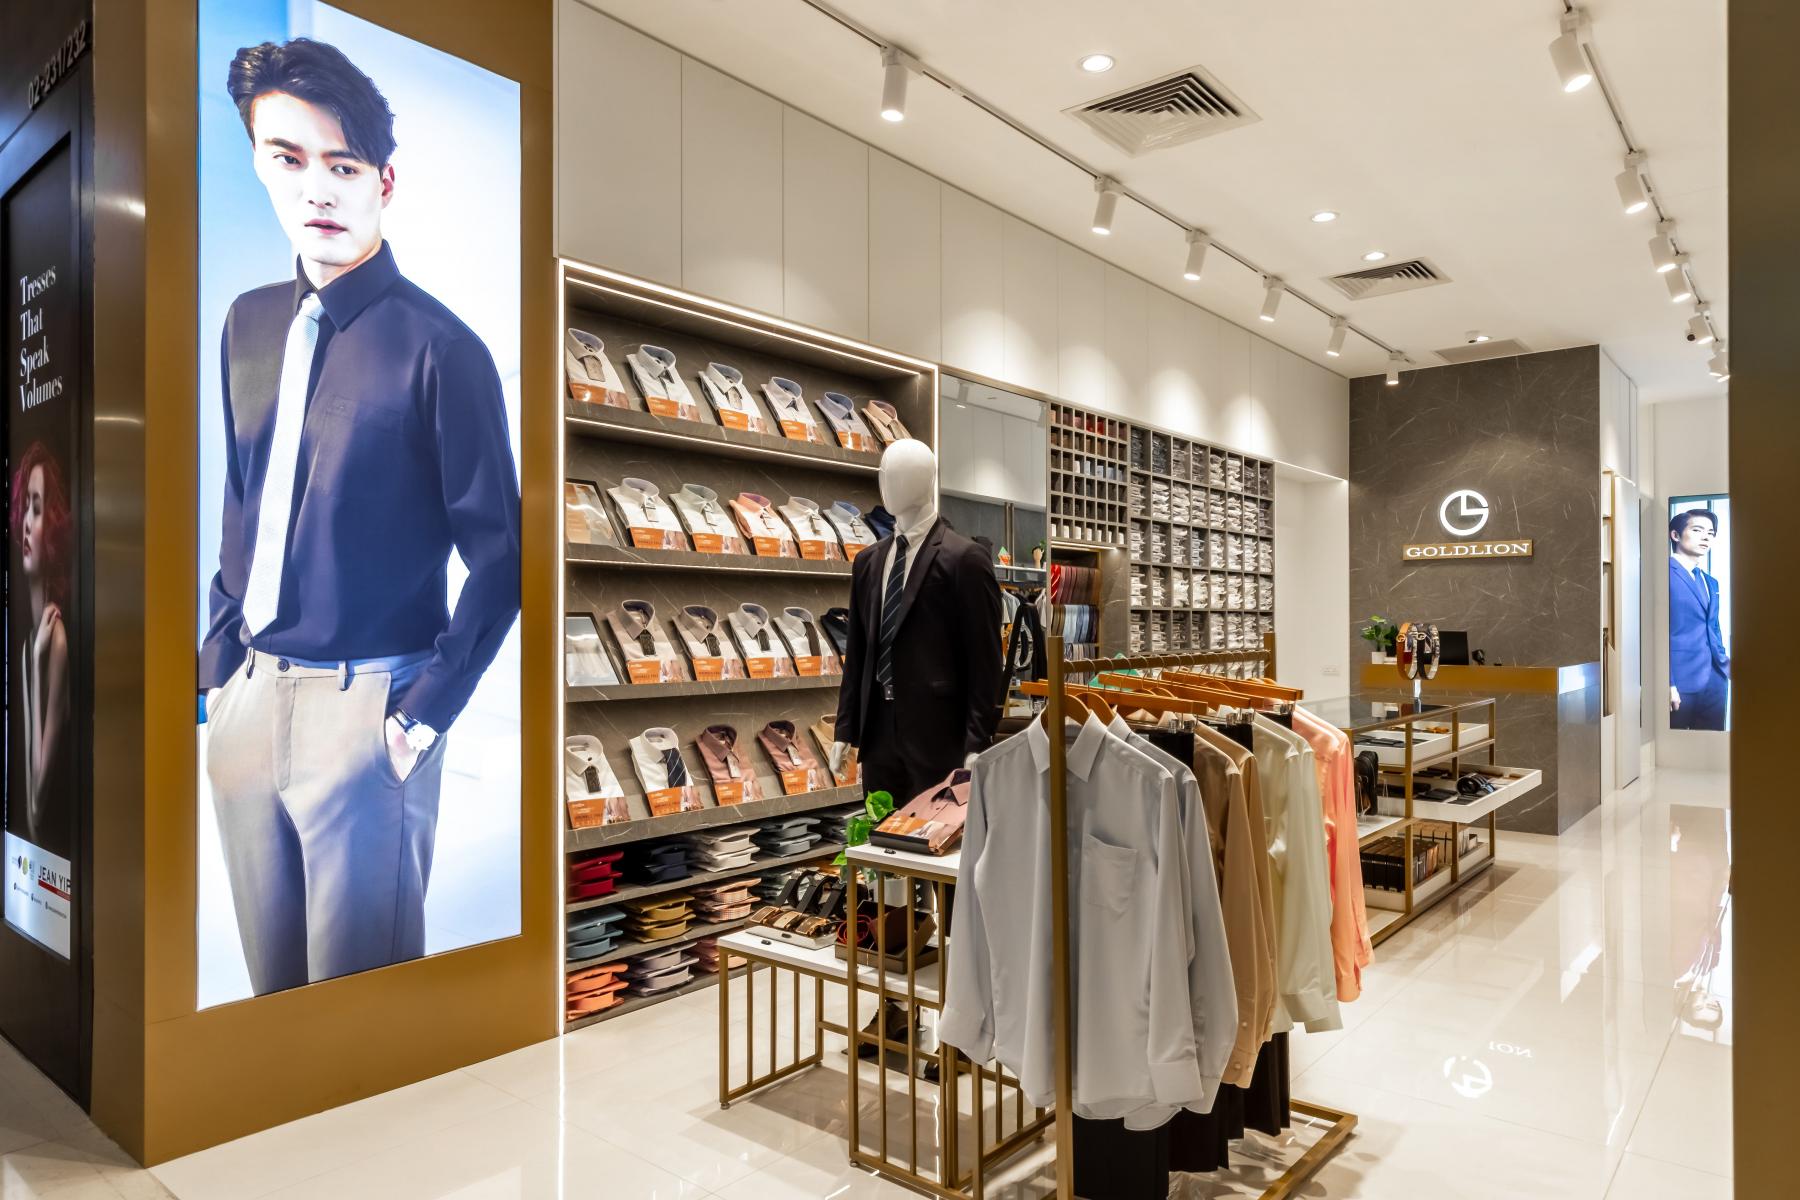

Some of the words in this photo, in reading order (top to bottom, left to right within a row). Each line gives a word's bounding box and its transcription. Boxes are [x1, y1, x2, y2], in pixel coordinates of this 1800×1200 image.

[20, 266, 56, 305] Tresses
[20, 308, 43, 341] That
[20, 336, 50, 383] Speak
[20, 376, 63, 413] Volumes
[1406, 543, 1529, 557] GOLDLION
[38, 865, 57, 886] JEAN
[59, 874, 71, 893] YIP
